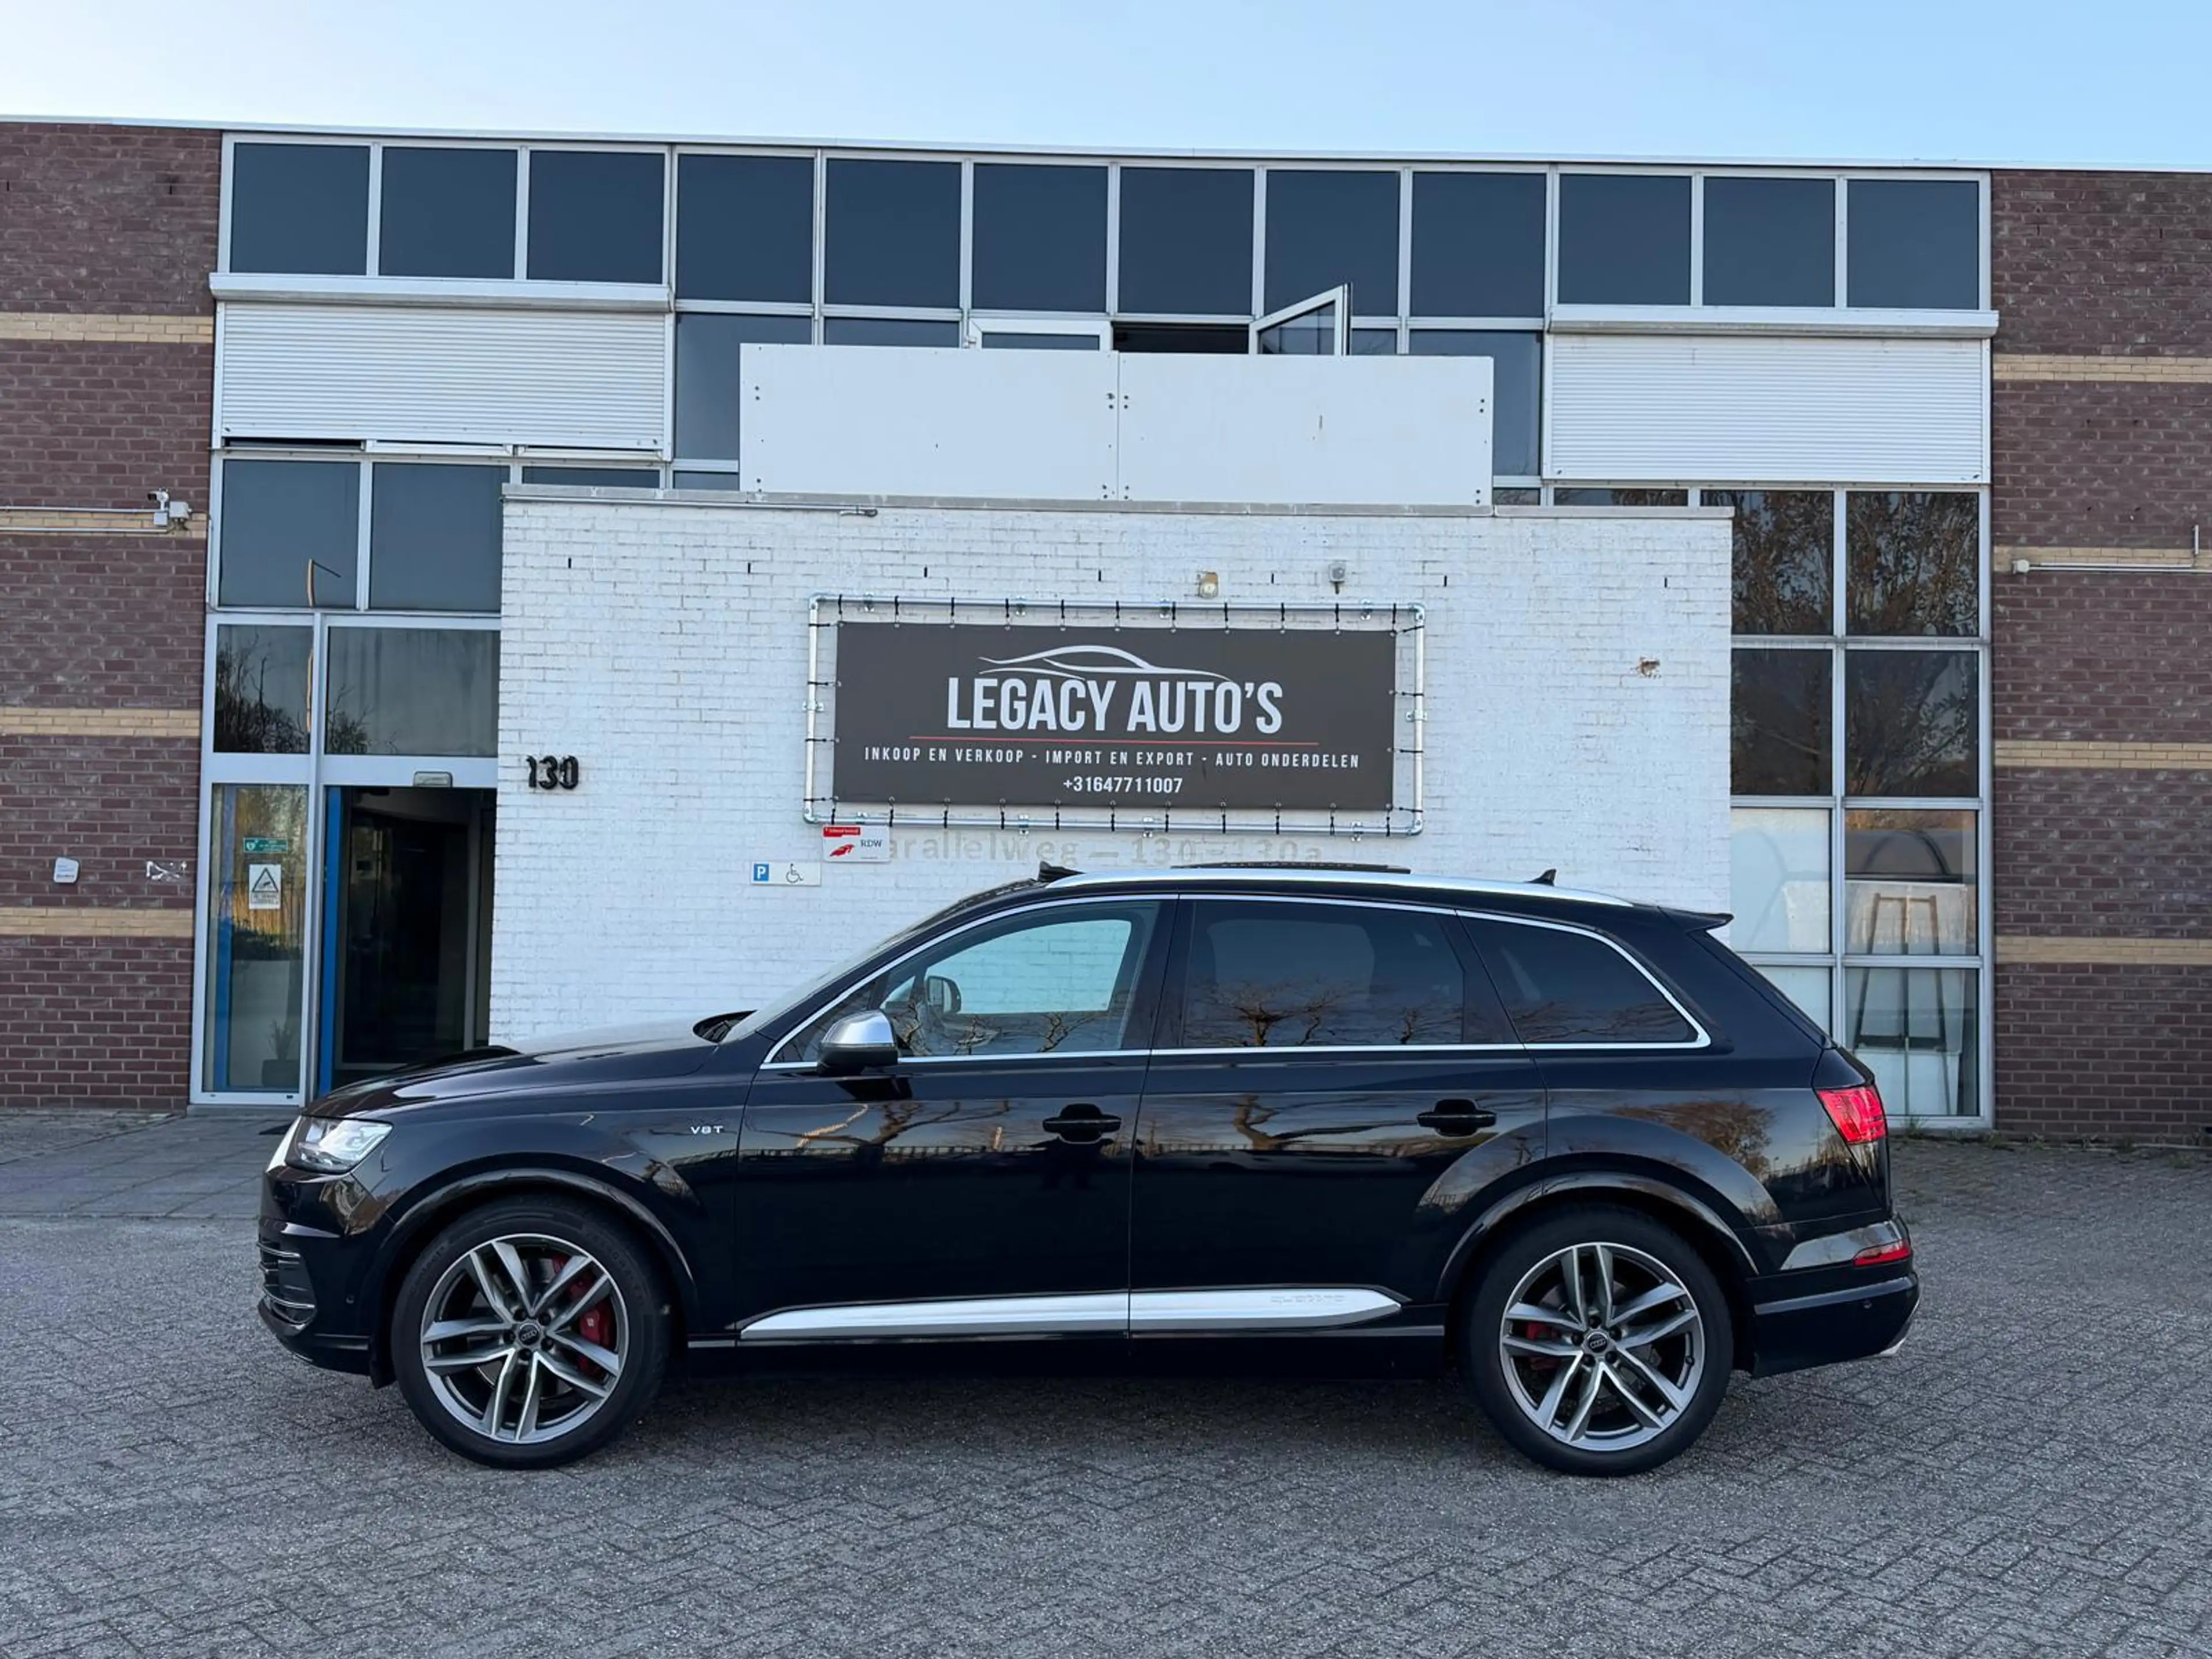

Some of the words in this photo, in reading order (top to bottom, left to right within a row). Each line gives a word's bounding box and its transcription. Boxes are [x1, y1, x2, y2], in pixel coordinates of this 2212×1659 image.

[948, 677, 1116, 731] LEGACY
[1126, 681, 1283, 734] AUTO'S
[865, 747, 921, 761] INKOOP
[928, 748, 946, 762] EN
[955, 748, 1024, 763] VERKOOP
[1045, 750, 1102, 764] IMPORT
[1109, 751, 1128, 765] EN
[1135, 752, 1194, 766] EXPORT
[1215, 752, 1253, 767] AUTO
[1260, 753, 1359, 768] ONDERDELEN
[525, 755, 579, 790] 130
[1062, 776, 1183, 794] +31647711007
[860, 839, 883, 848] RDW
[889, 831, 1078, 866] arallelweg
[757, 866, 767, 880] P
